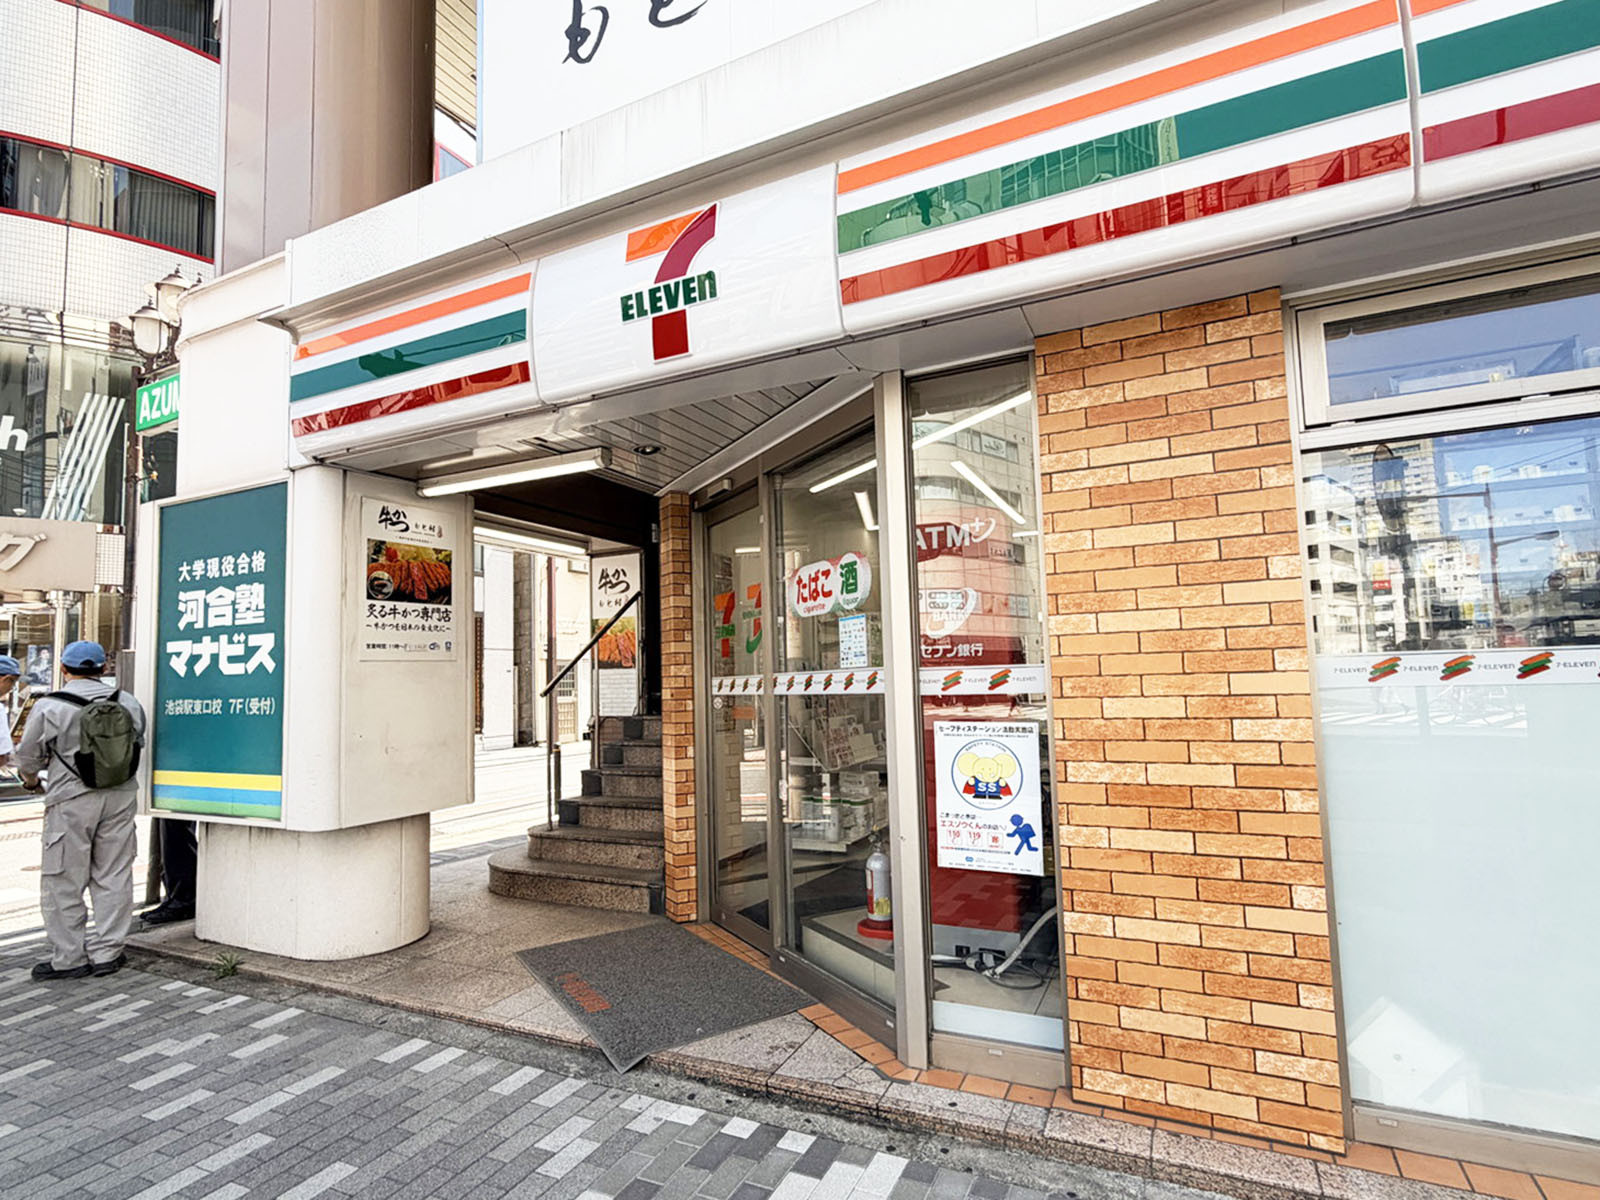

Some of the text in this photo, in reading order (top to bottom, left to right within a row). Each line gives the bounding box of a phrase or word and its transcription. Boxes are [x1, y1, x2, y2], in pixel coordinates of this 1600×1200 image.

[620, 270, 717, 322] ELEVEn
[917, 524, 971, 550] ATM
[178, 551, 267, 583] 大学現役合格
[840, 560, 858, 596] 酒
[796, 568, 834, 605] たばこ
[178, 582, 266, 632] 河合塾
[366, 603, 452, 622] 炙る牛かつ専門店
[166, 632, 277, 678] マナビス
[165, 697, 276, 716] 池袋駅東口校 7F(受付)
[977, 782, 998, 793] SS
